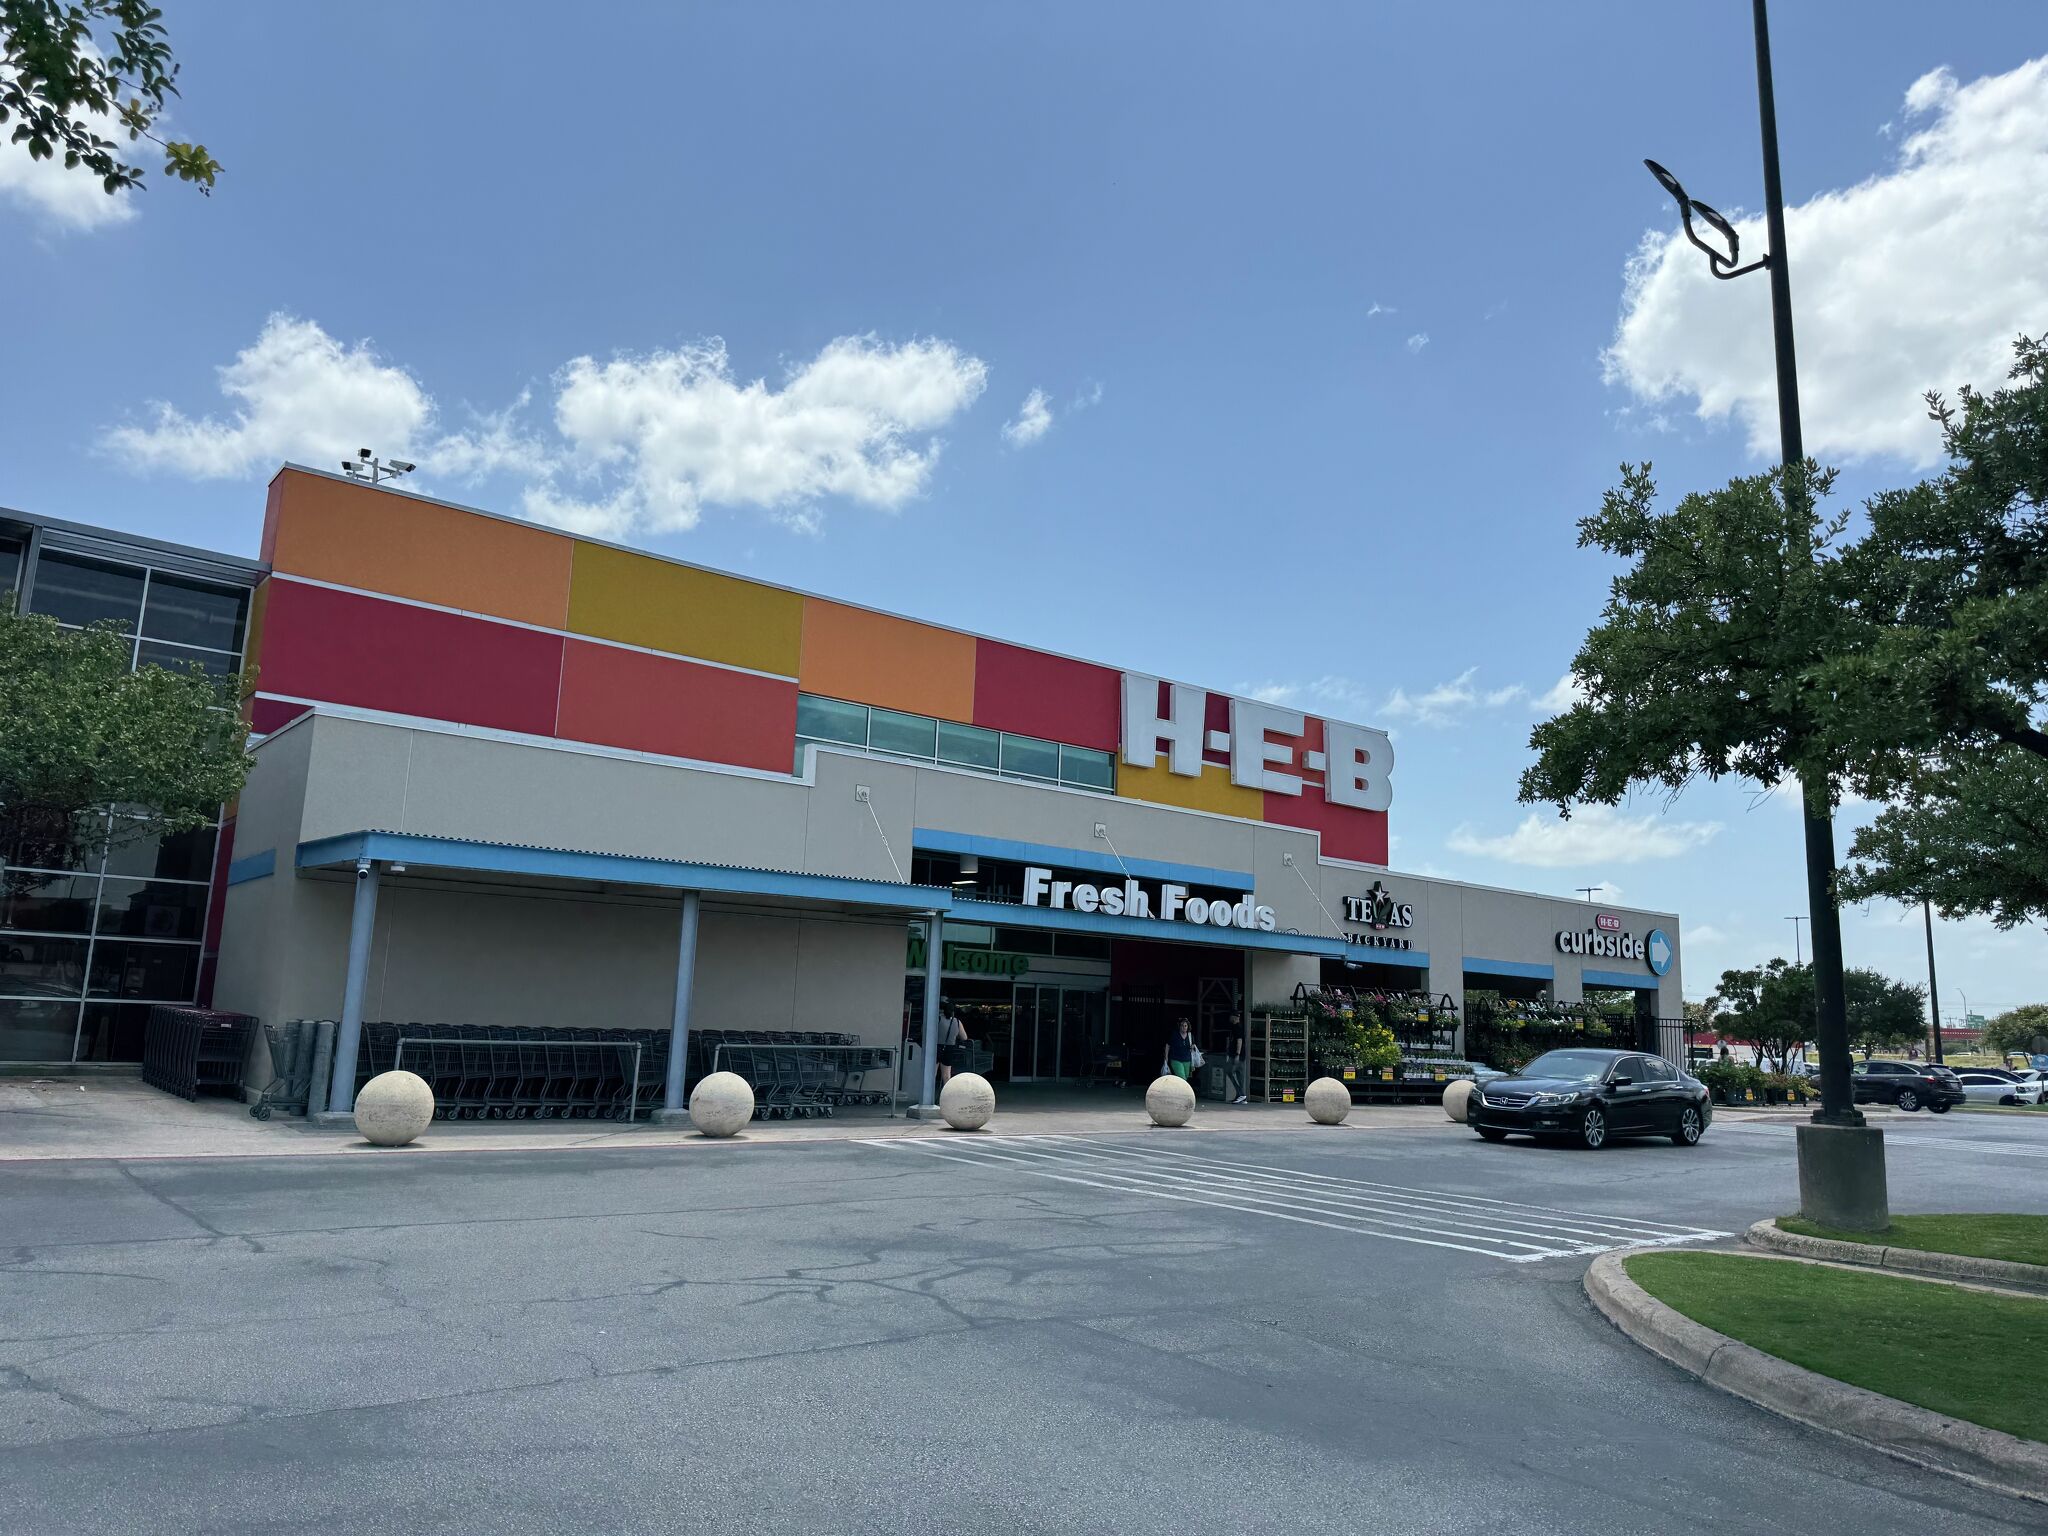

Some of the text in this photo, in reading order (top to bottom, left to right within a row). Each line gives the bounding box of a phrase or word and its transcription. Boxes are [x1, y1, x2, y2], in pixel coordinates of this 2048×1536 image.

[1120, 672, 1394, 812] H-E-B
[1022, 867, 1276, 932] Fresh Foods
[906, 939, 1029, 976] Wlcome
[1345, 933, 1413, 950] BACKYARD
[1559, 928, 1645, 960] curbside
